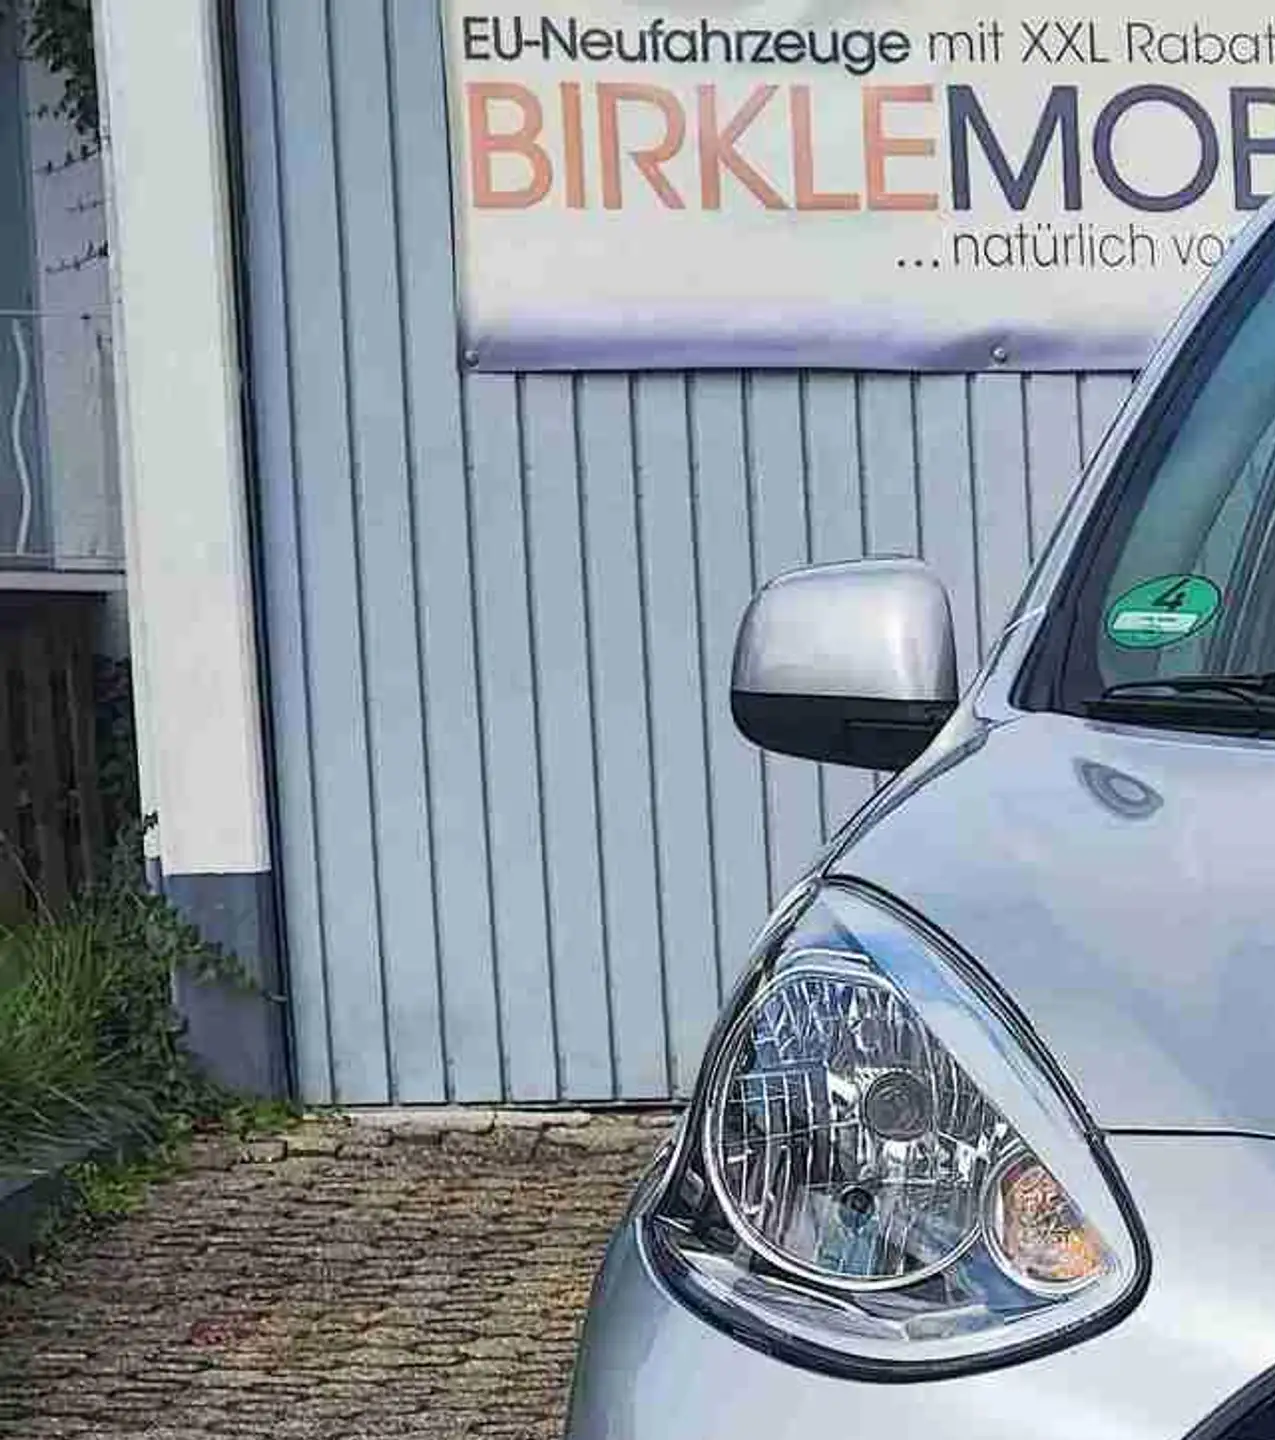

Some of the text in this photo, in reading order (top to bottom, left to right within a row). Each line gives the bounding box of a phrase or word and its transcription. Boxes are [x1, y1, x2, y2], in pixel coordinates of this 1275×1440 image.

[463, 16, 911, 75] EU-Neufahrzeuge
[927, 21, 1004, 65] mit
[1020, 21, 1110, 66] XXL
[1171, 234, 1236, 269] vo
[1151, 578, 1191, 611] 4
